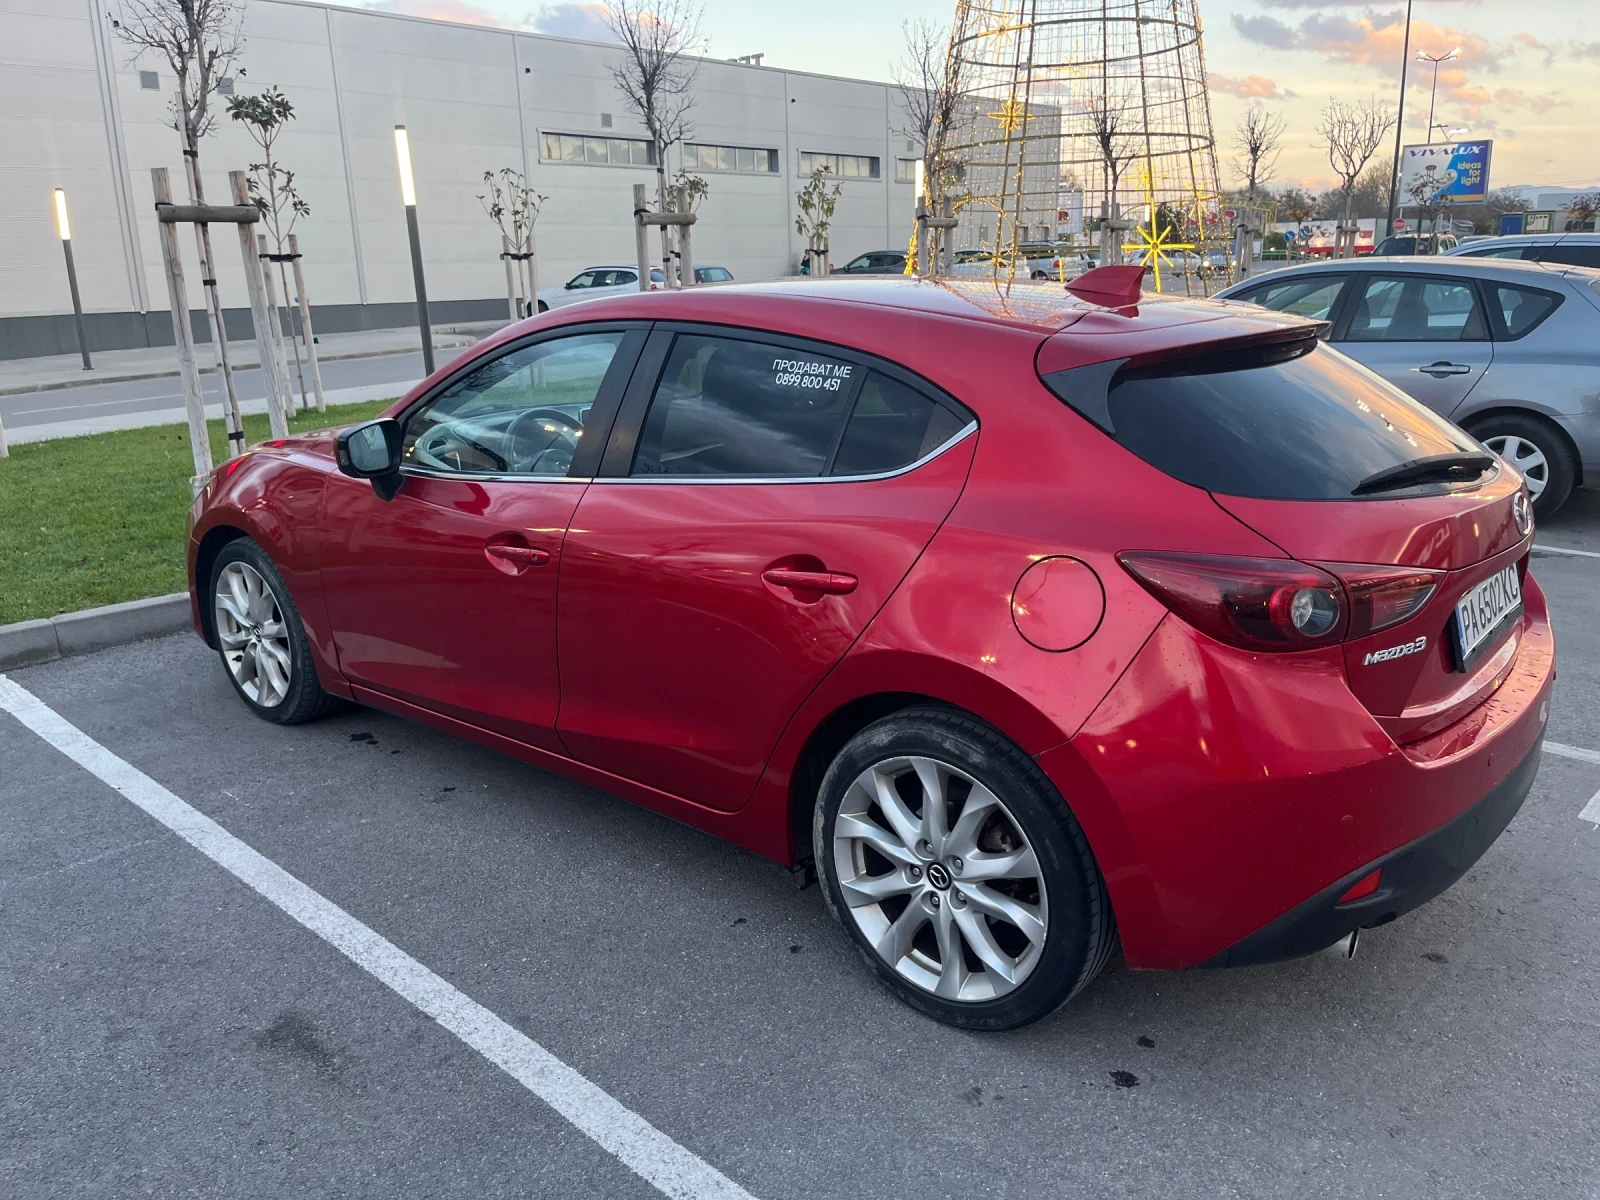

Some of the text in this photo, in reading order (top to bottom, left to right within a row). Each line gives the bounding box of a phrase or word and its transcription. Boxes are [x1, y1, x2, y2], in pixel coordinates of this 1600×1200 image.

[1410, 146, 1483, 157] VIVALUX
[1457, 161, 1482, 170] ideas
[1469, 169, 1481, 177] for
[1460, 177, 1480, 186] light
[772, 359, 852, 378] ПРОДАВАТ МЕ
[775, 373, 841, 391] 0899 800 451
